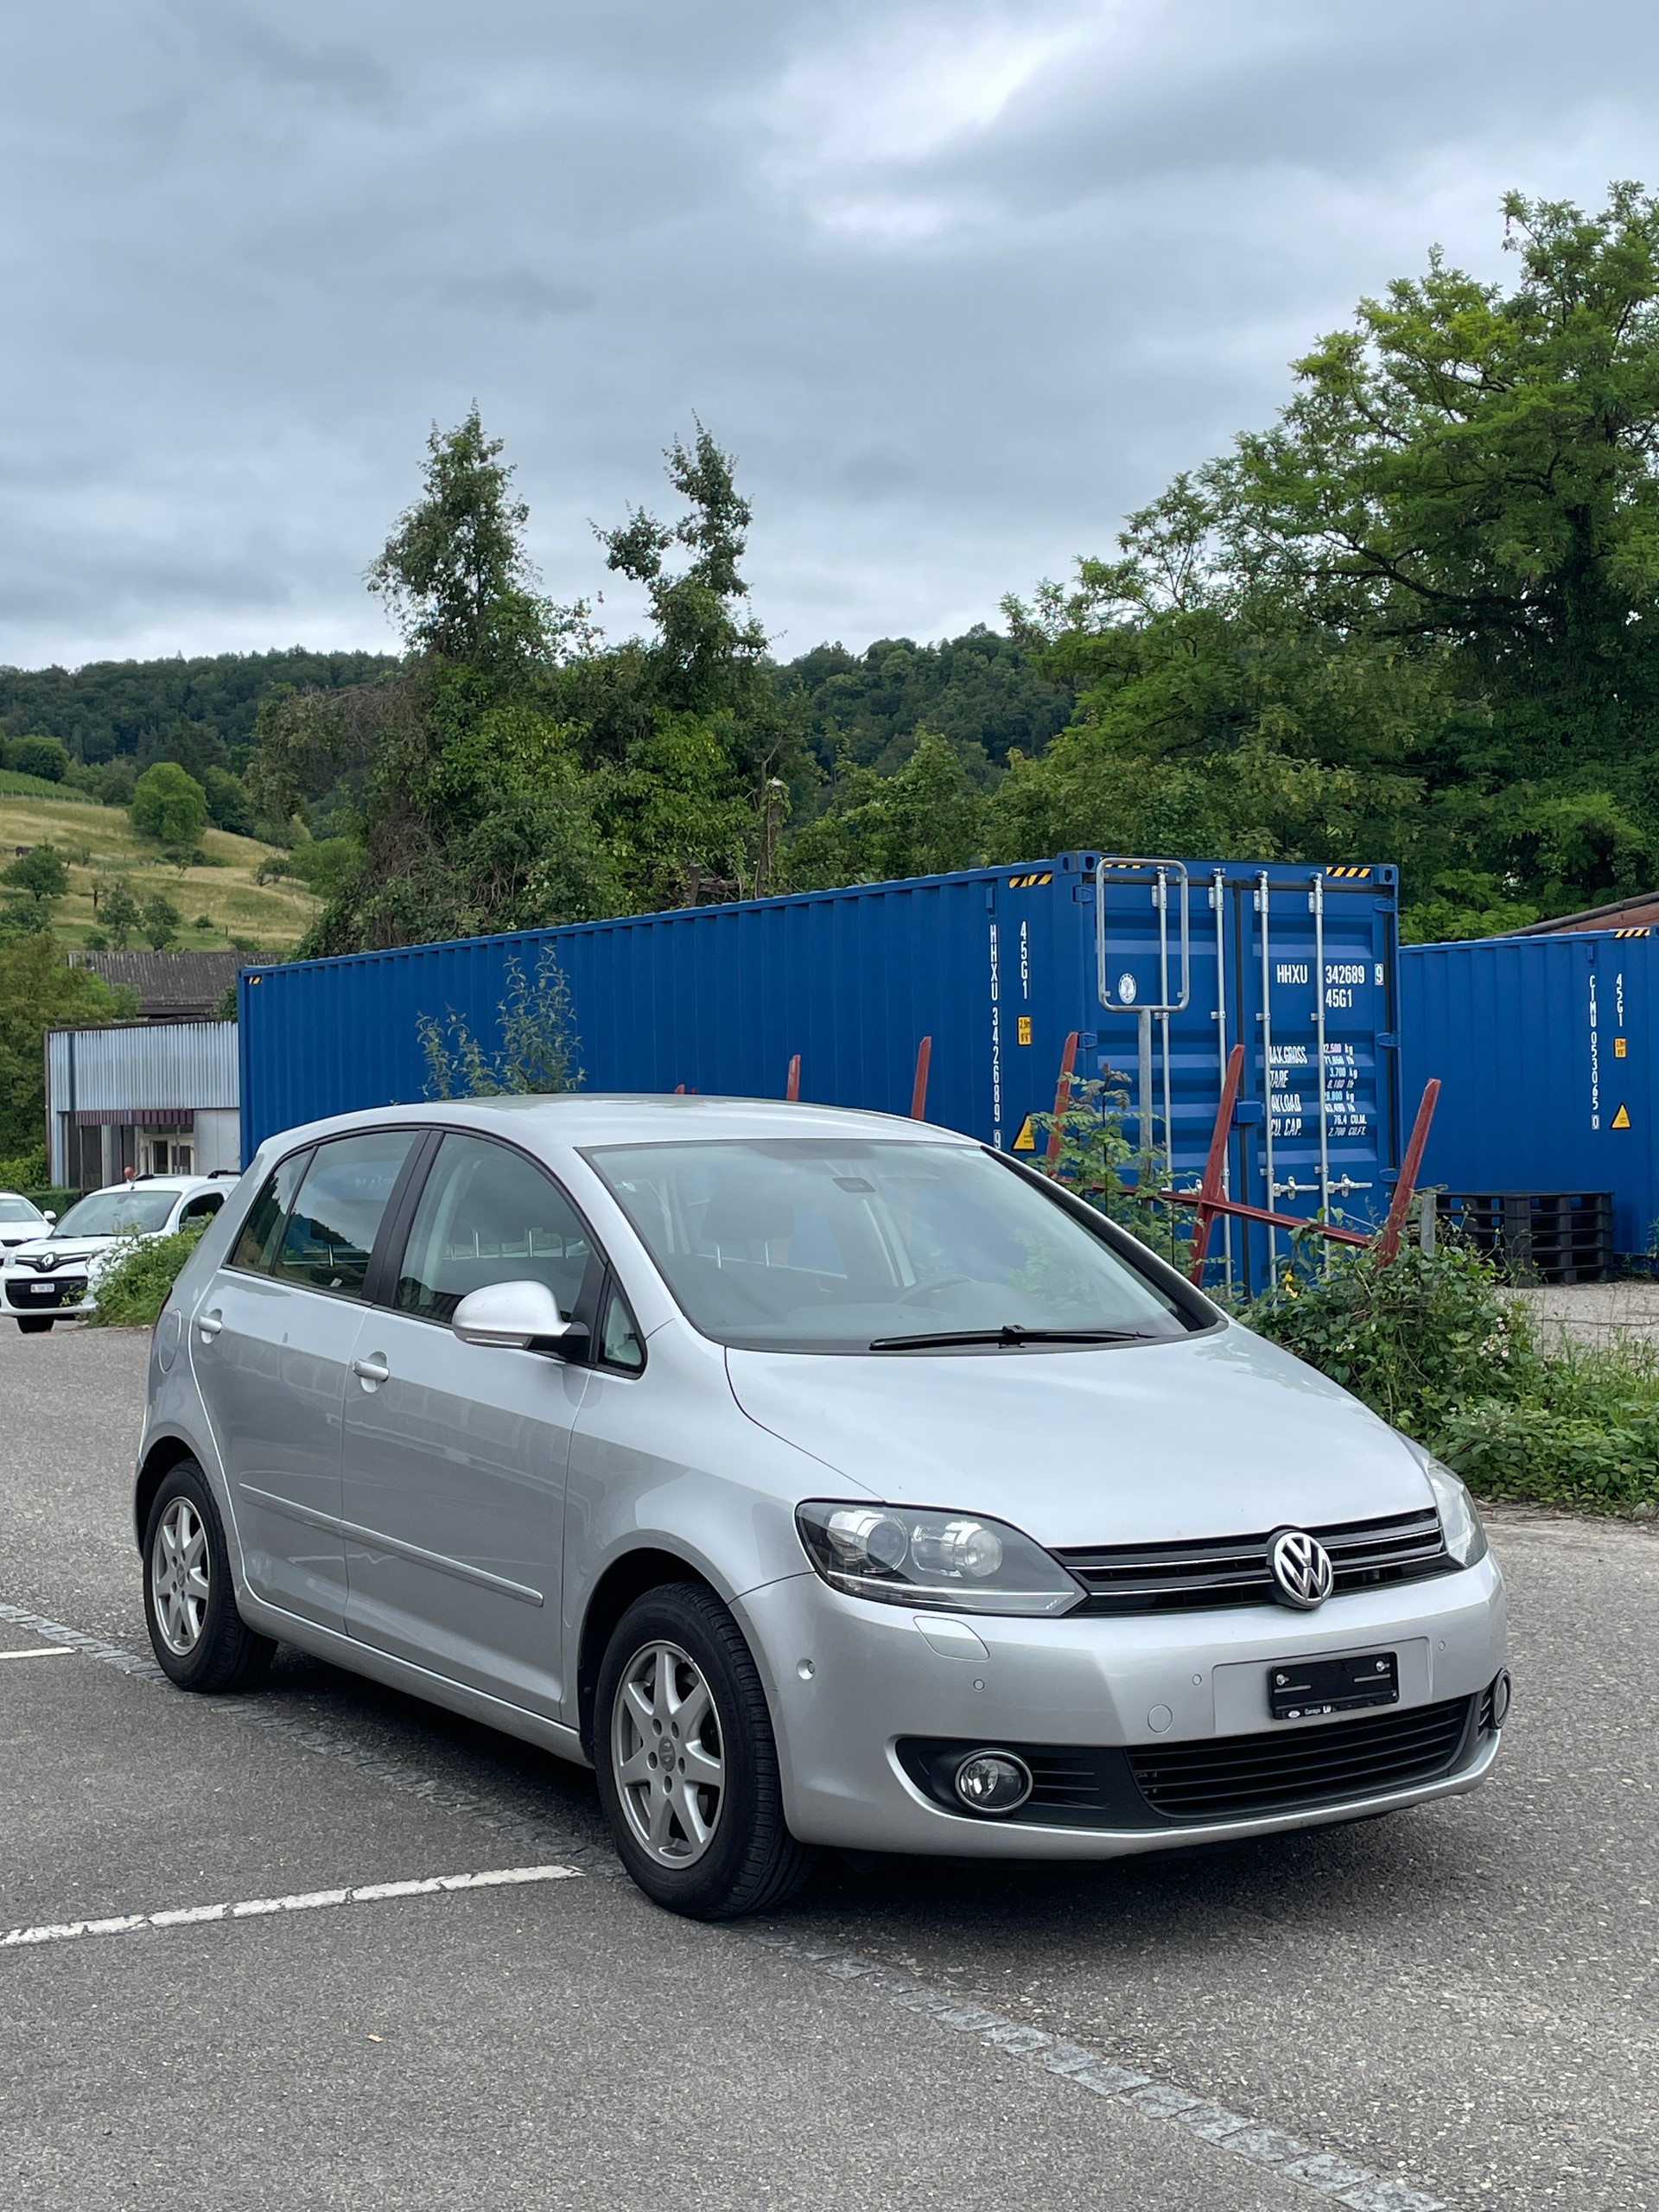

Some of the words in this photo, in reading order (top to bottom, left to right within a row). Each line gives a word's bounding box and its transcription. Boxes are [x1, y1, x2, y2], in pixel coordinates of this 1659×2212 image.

[989, 925, 998, 1001] HHXU
[1276, 964, 1308, 983] HHXU
[1325, 965, 1365, 984] 342689
[1375, 963, 1383, 985] 9
[1325, 988, 1352, 1007] 45G1
[1269, 1070, 1288, 1088] TARE
[1349, 1067, 1358, 1079] kg
[1271, 1094, 1301, 1113] AYLOAD
[1346, 1090, 1355, 1103] kg
[1284, 1118, 1302, 1136] CAP.
[1274, 1532, 1332, 1606] VW
